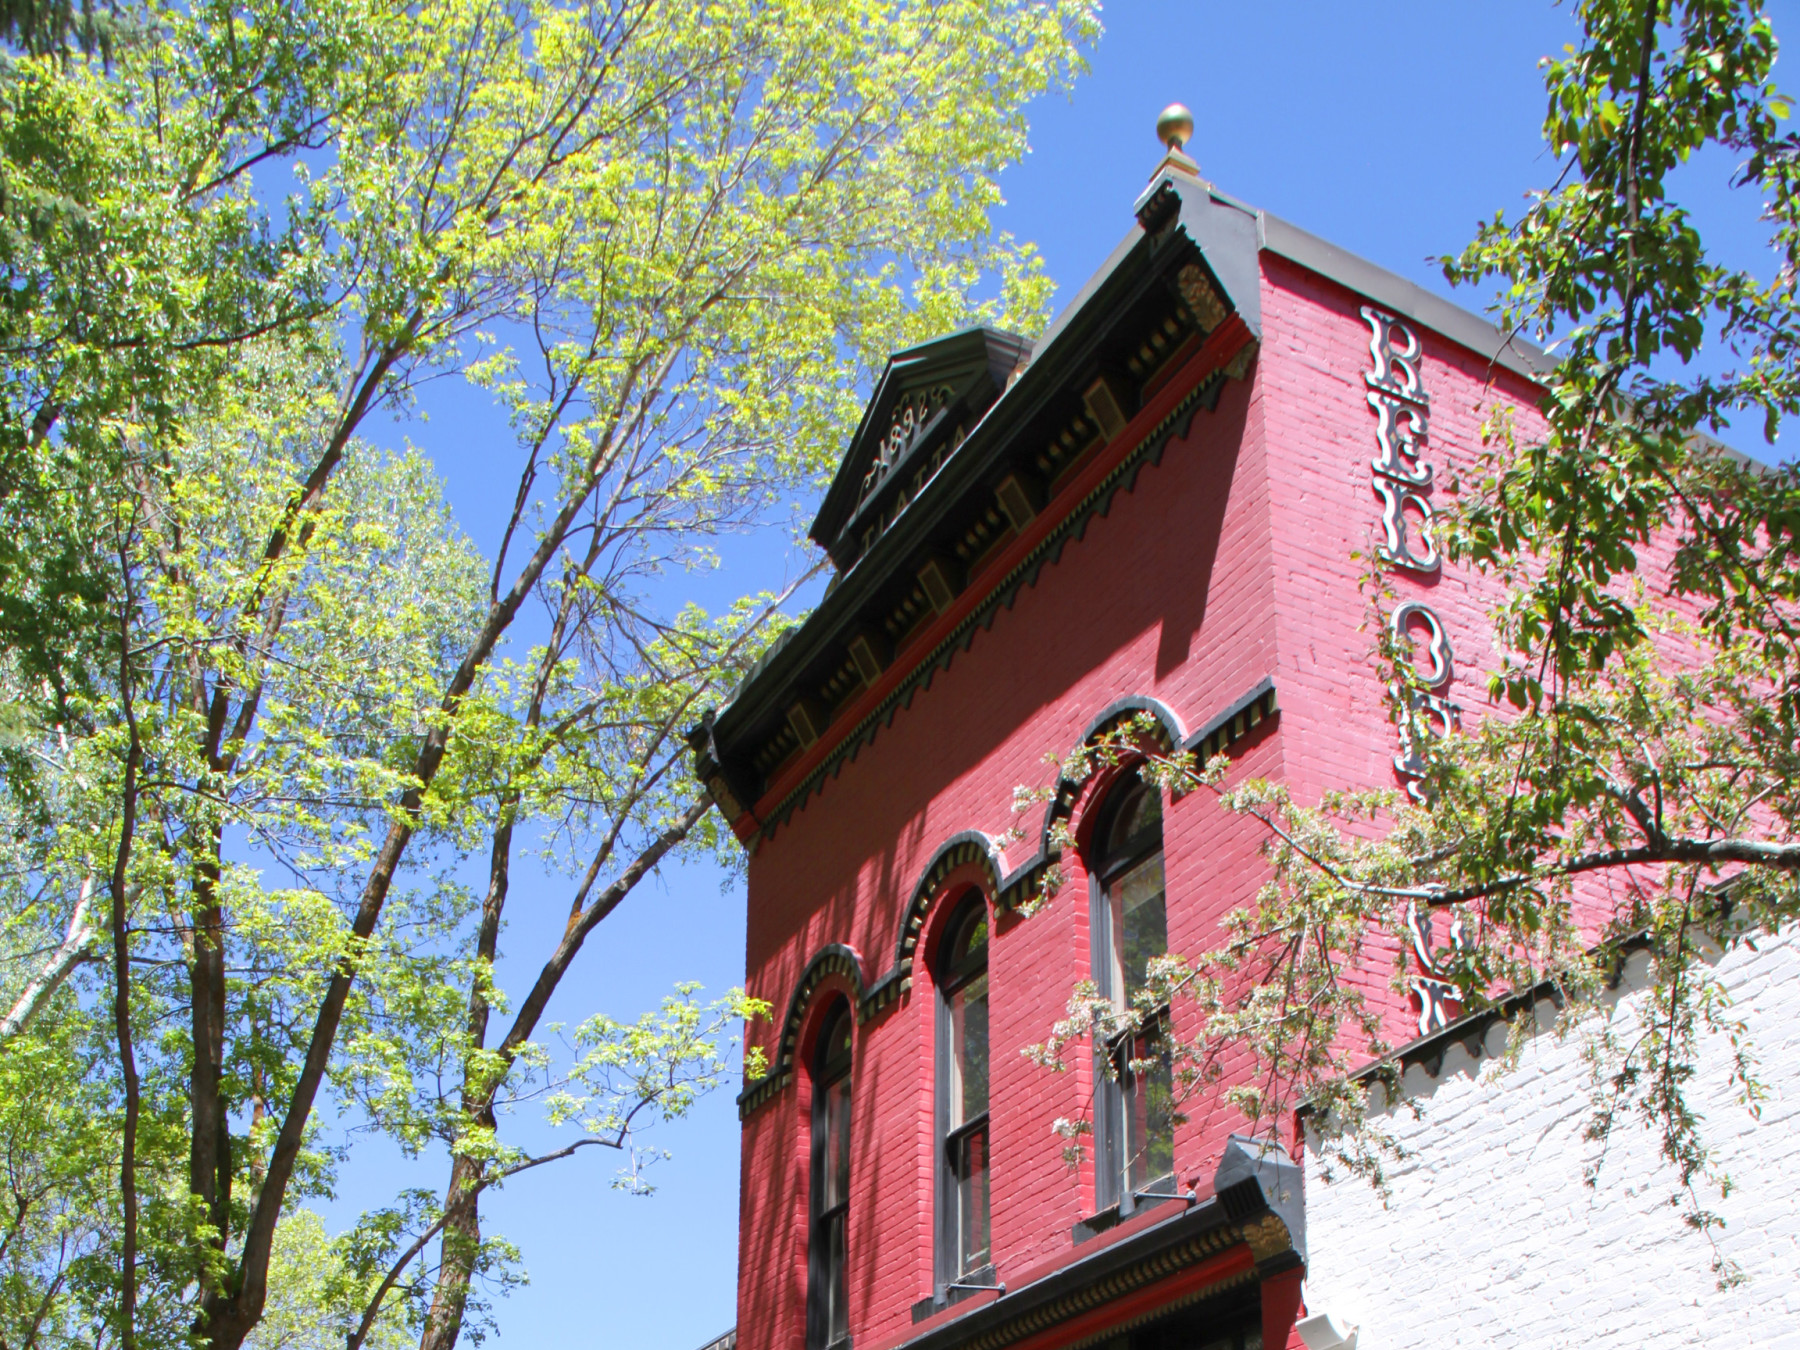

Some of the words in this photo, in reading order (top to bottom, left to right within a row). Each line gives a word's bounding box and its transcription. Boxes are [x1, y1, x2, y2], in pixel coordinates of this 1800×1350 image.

[879, 390, 928, 470] 1892
[1360, 305, 1441, 572] RED
[1389, 602, 1474, 1036] ONON
